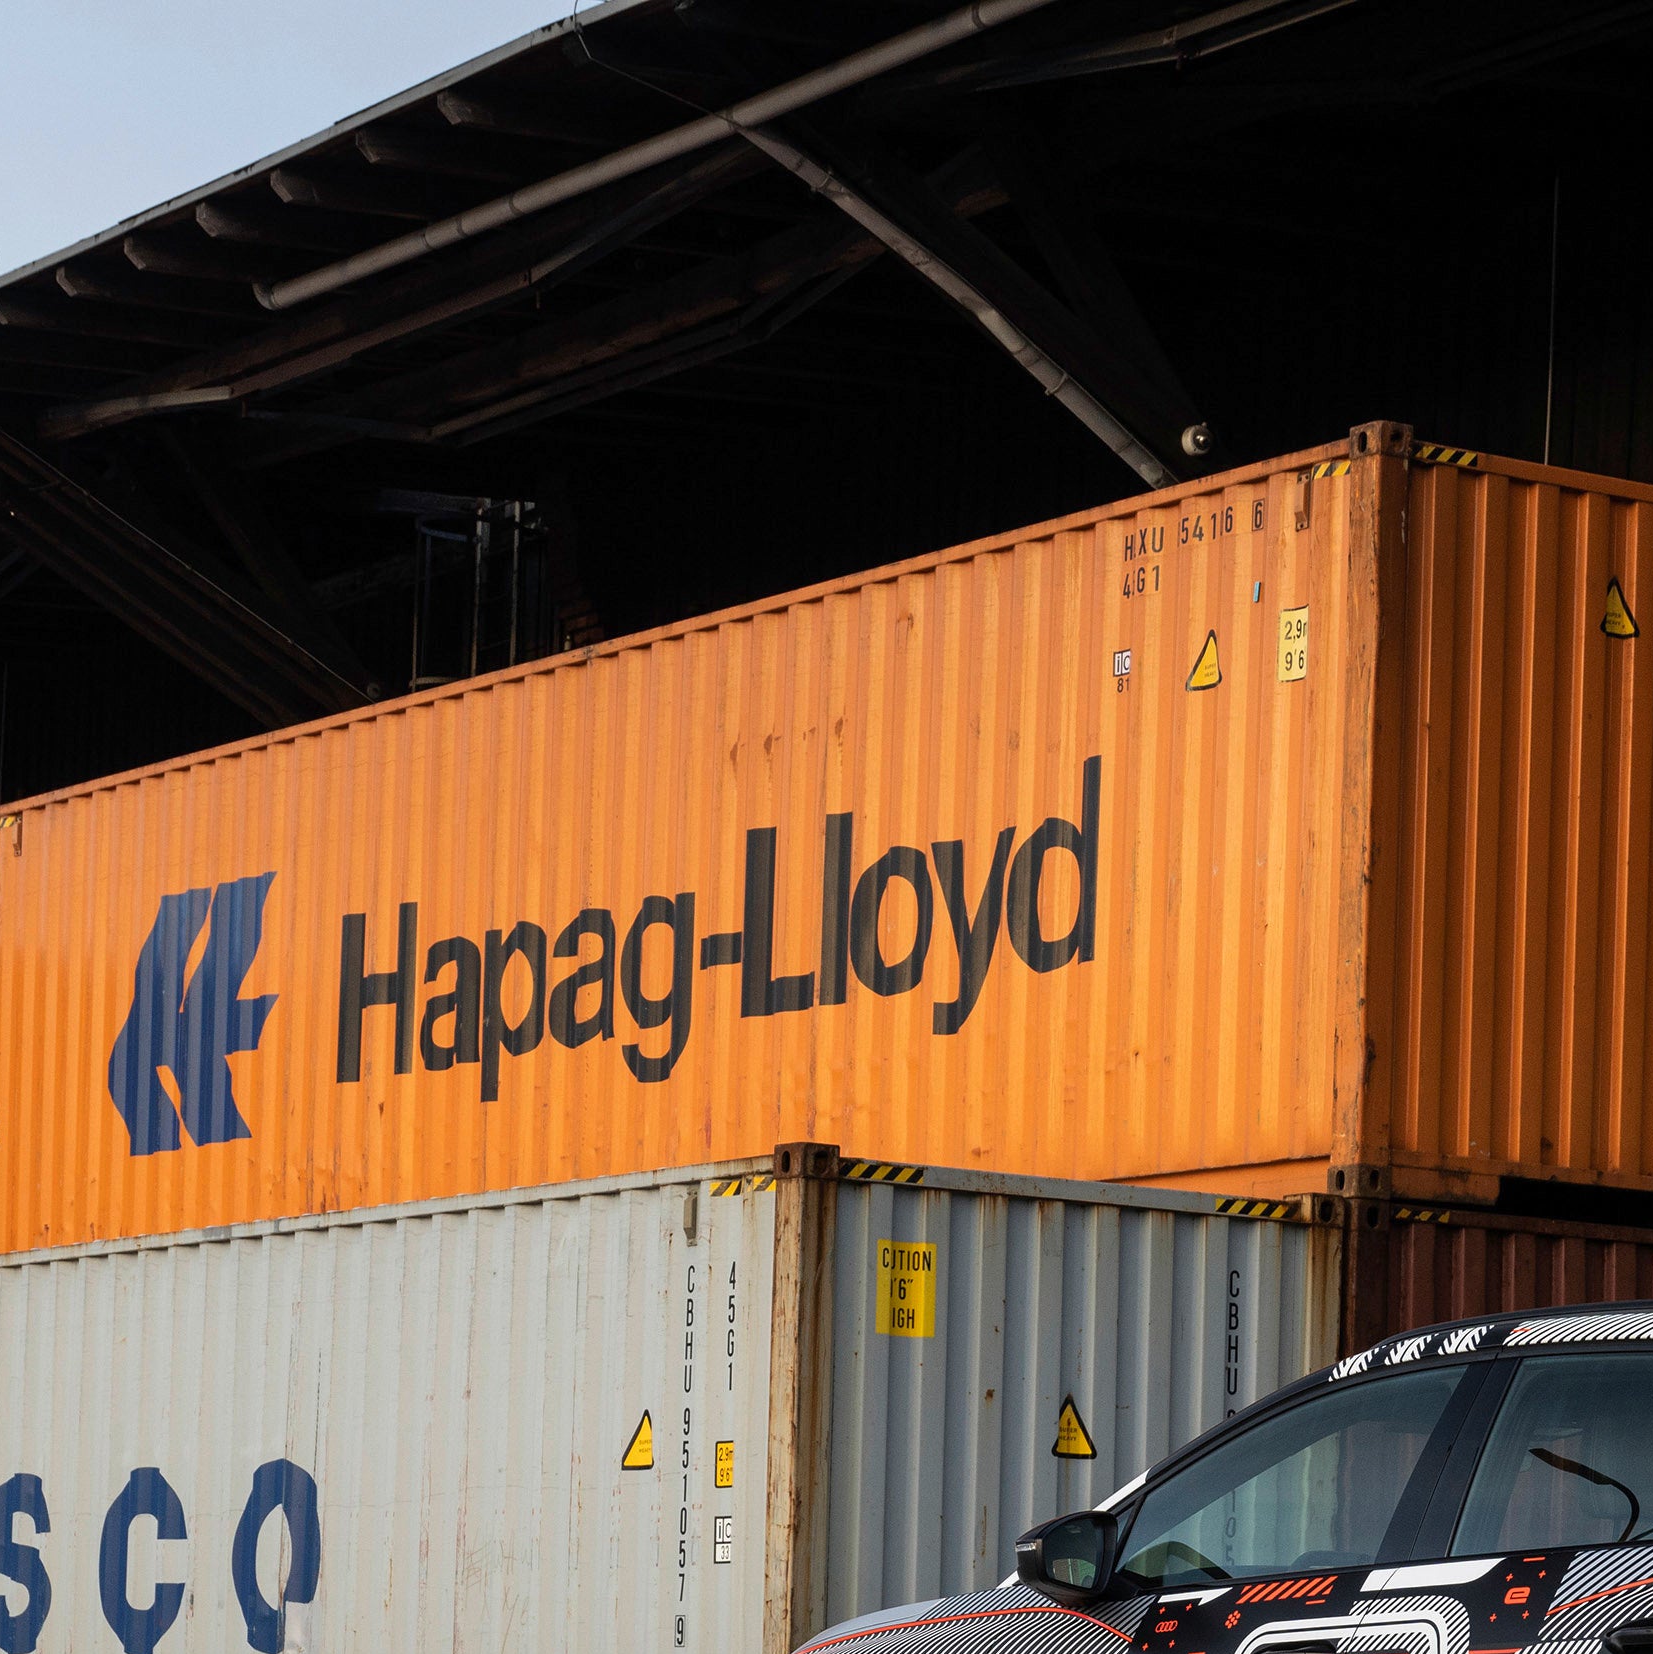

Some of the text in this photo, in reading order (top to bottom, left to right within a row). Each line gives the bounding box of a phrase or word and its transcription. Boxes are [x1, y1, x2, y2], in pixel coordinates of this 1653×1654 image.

[336, 754, 1102, 1103] Hapag-Lloyd
[684, 1265, 695, 1393] CBHU
[727, 1261, 736, 1390] 45G1
[1227, 1270, 1240, 1395] CBHU
[678, 1407, 691, 1601] 951057
